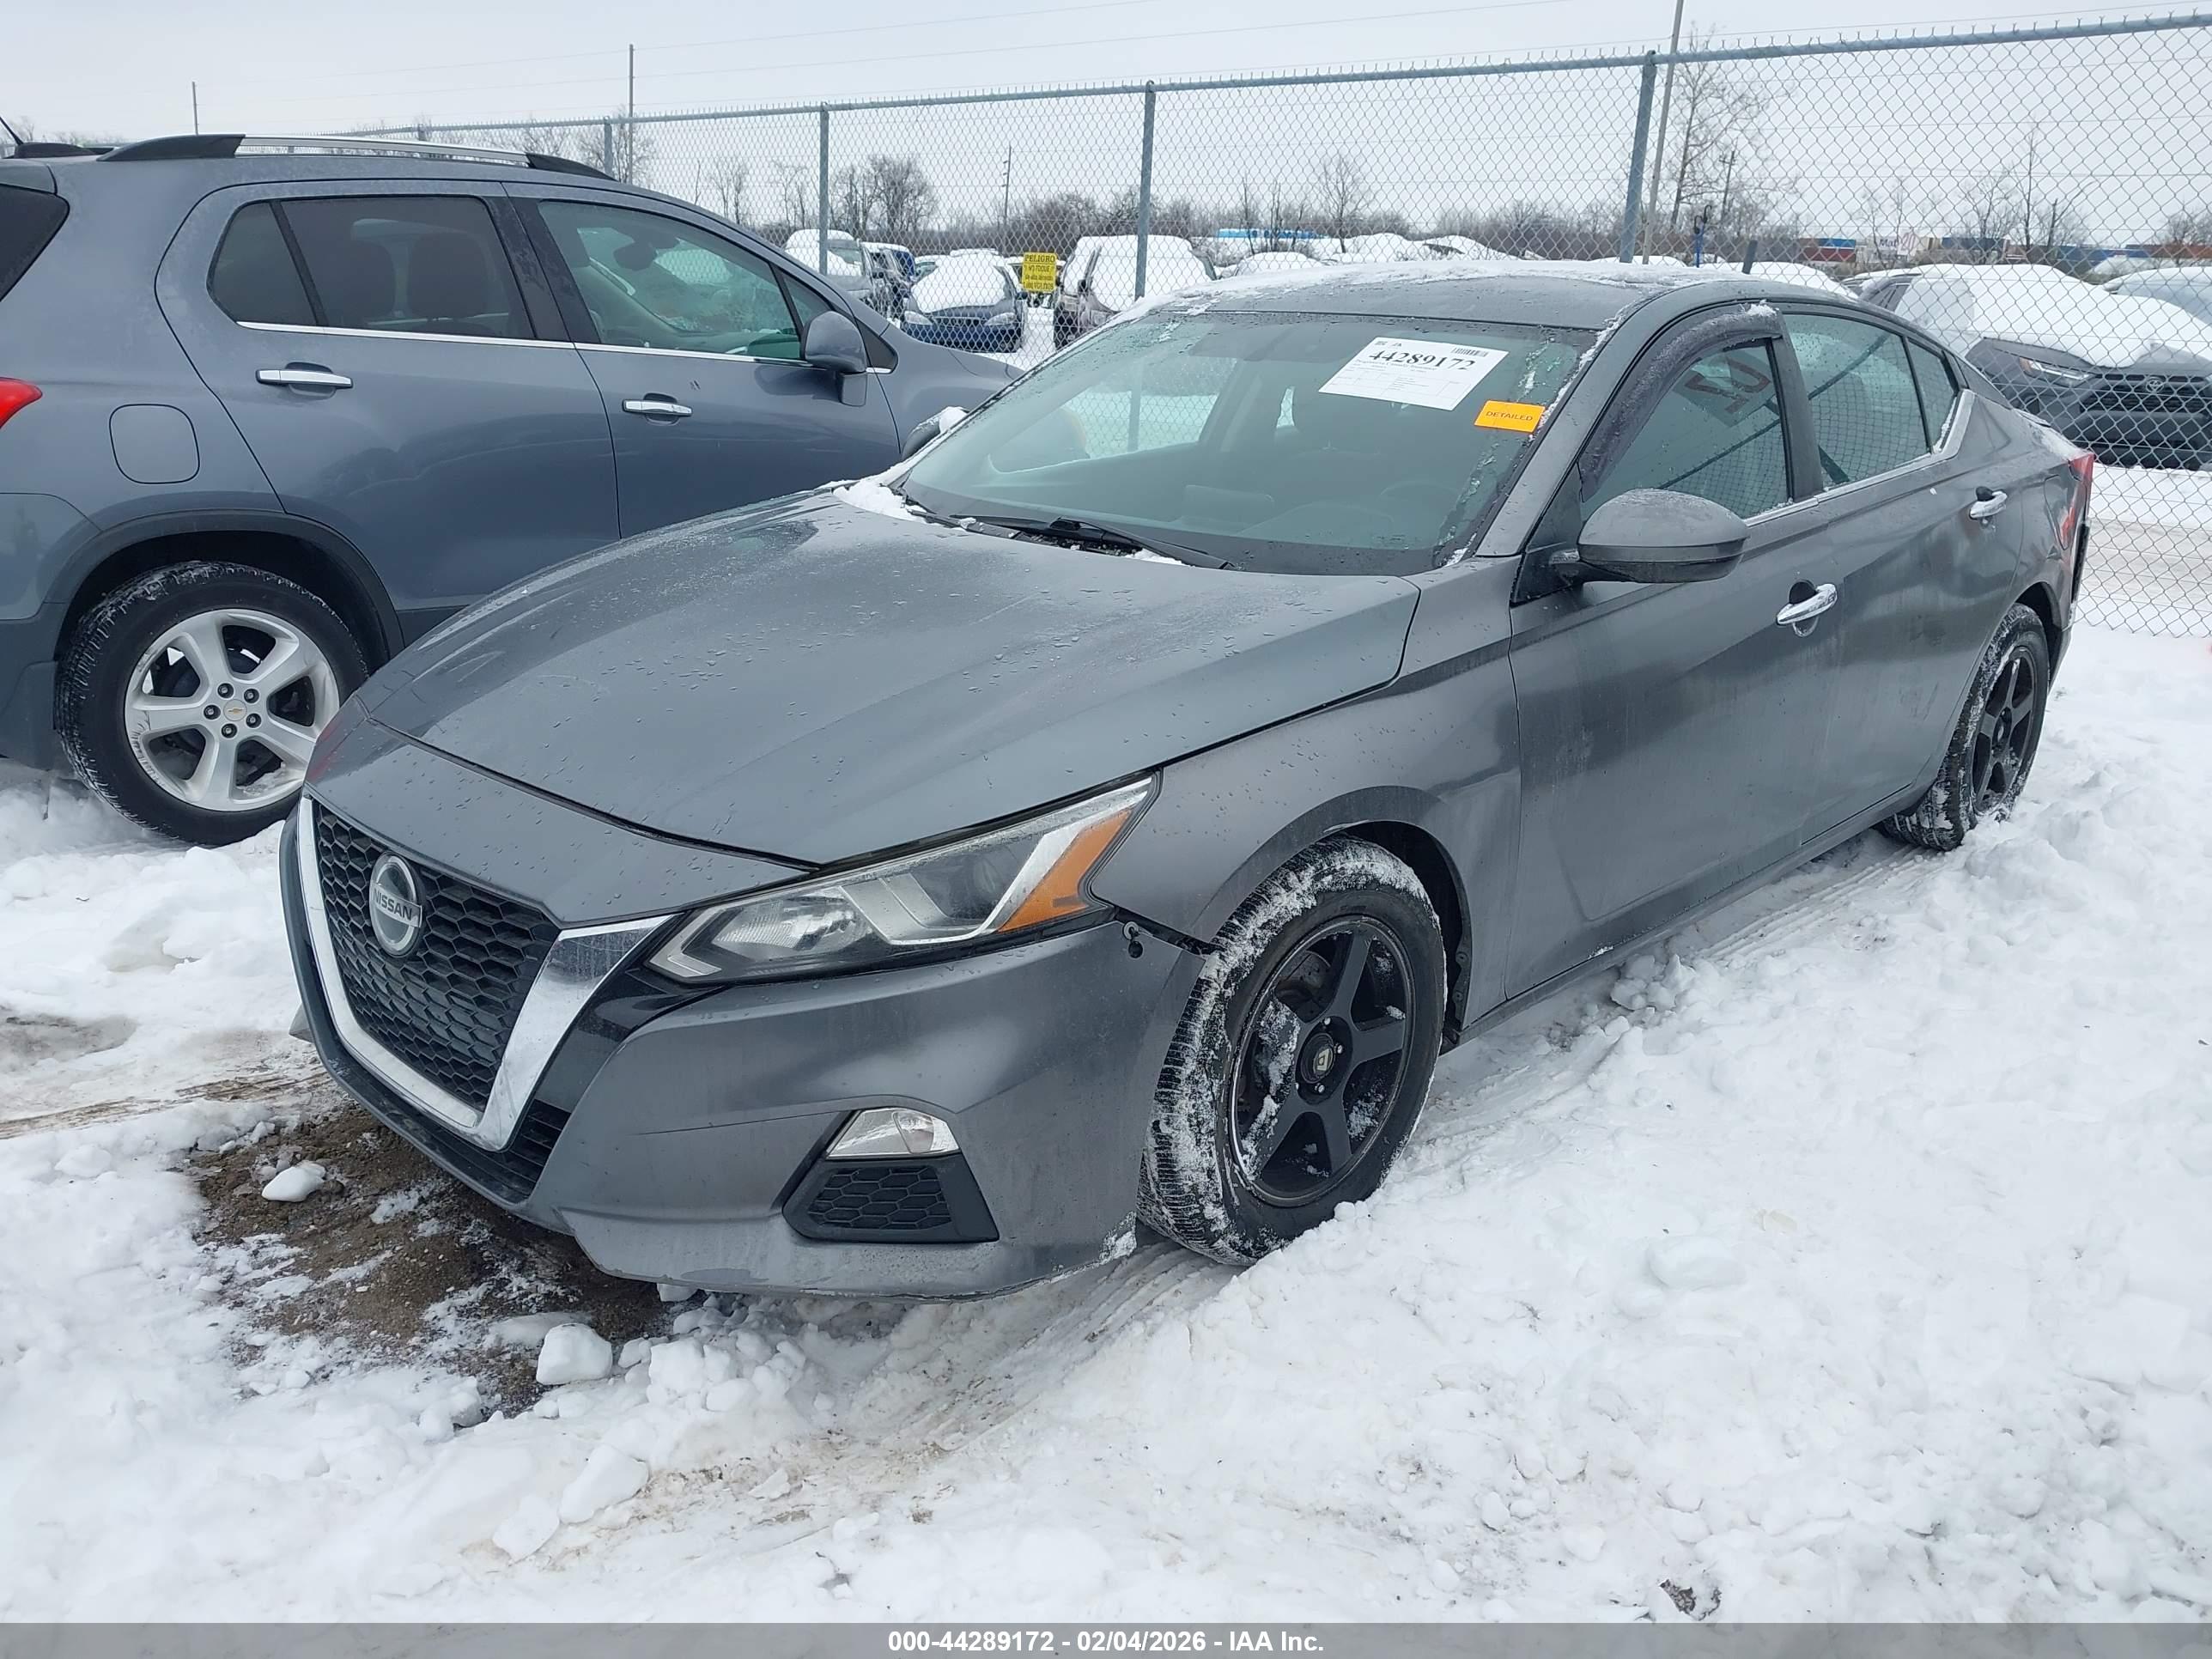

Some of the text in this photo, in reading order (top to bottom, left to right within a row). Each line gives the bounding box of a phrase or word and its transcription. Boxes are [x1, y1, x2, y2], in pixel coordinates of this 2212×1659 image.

[1024, 254, 1055, 263] PELIGRO
[1369, 350, 1476, 370] 44289172
[1486, 410, 1534, 421] DETAILED
[374, 888, 412, 921] NISSAN
